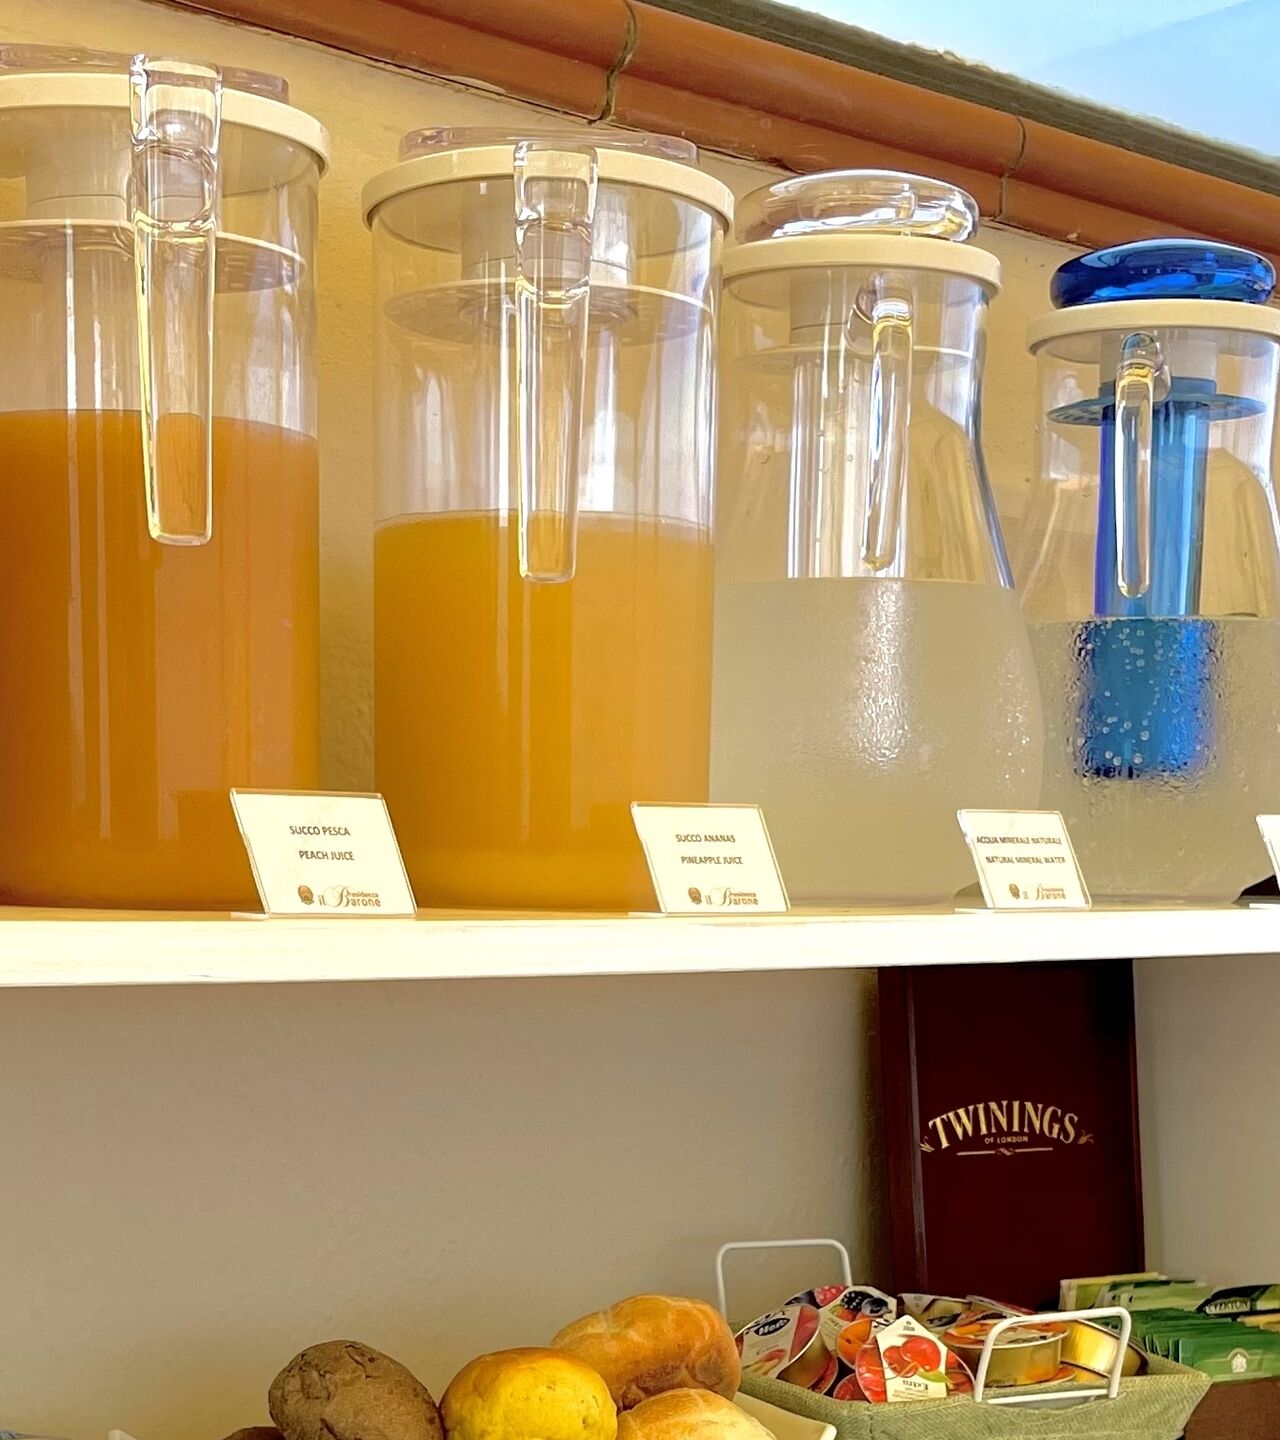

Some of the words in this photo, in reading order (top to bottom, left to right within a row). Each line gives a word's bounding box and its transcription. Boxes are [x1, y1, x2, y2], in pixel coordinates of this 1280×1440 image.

[289, 825, 321, 835] SUCCO
[322, 826, 351, 837] PESCA
[675, 834, 702, 843] SUCCO
[704, 834, 736, 843] ANANAS
[298, 850, 329, 860] PEACH
[331, 851, 355, 861] JUICE
[681, 856, 721, 865] PINEAPPLE
[723, 856, 744, 865] JUICE
[928, 1100, 1078, 1149] TWININGS
[997, 1135, 1028, 1144] LONDON
